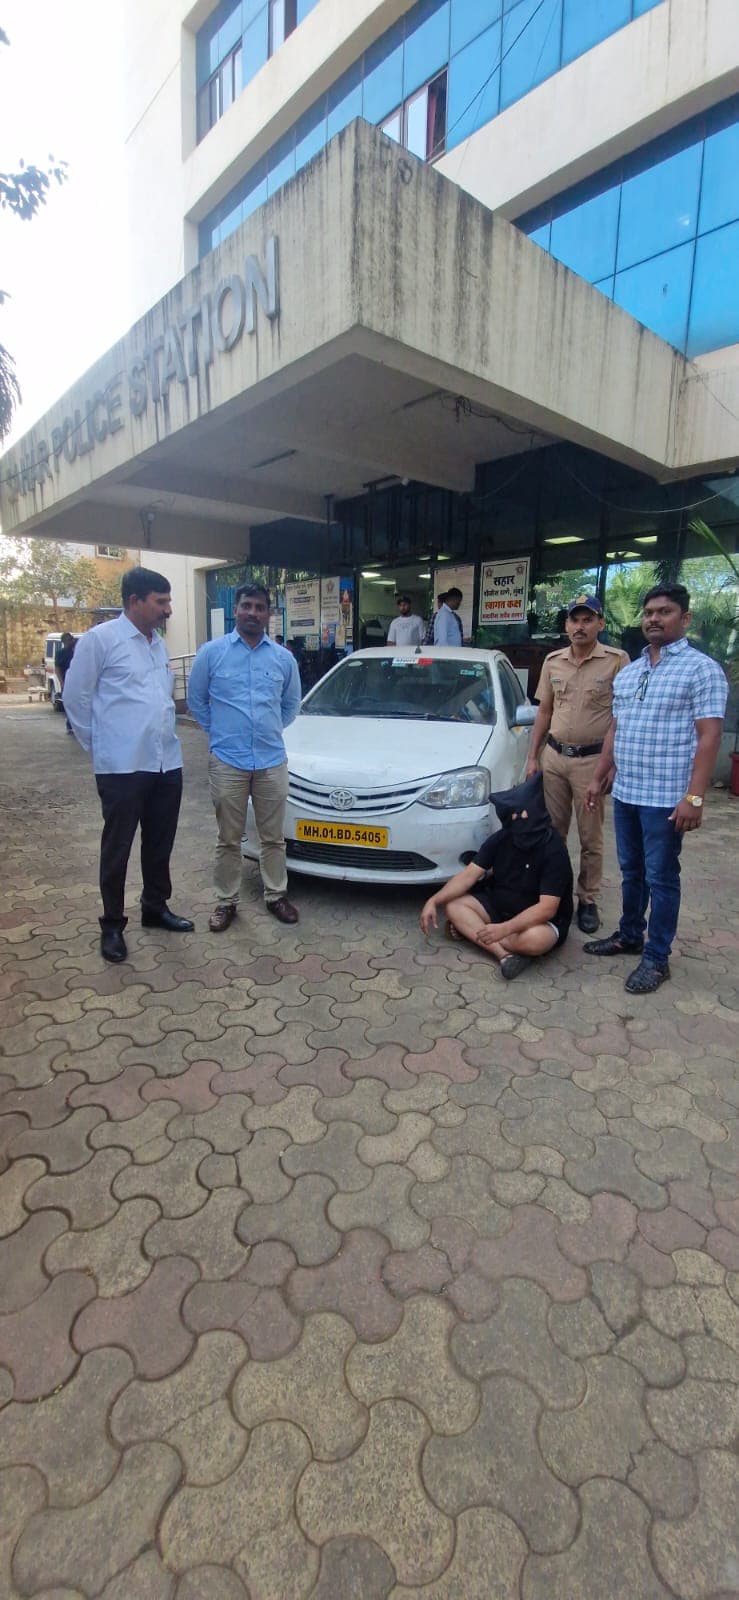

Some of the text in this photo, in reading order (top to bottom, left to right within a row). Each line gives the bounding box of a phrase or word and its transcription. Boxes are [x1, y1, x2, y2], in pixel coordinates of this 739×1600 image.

[52, 378, 125, 473] POLICE
[129, 235, 281, 417] STATION
[494, 575, 515, 586] सहार
[485, 601, 506, 610] स्वागत
[303, 825, 381, 843] MH.01.BD.5405
